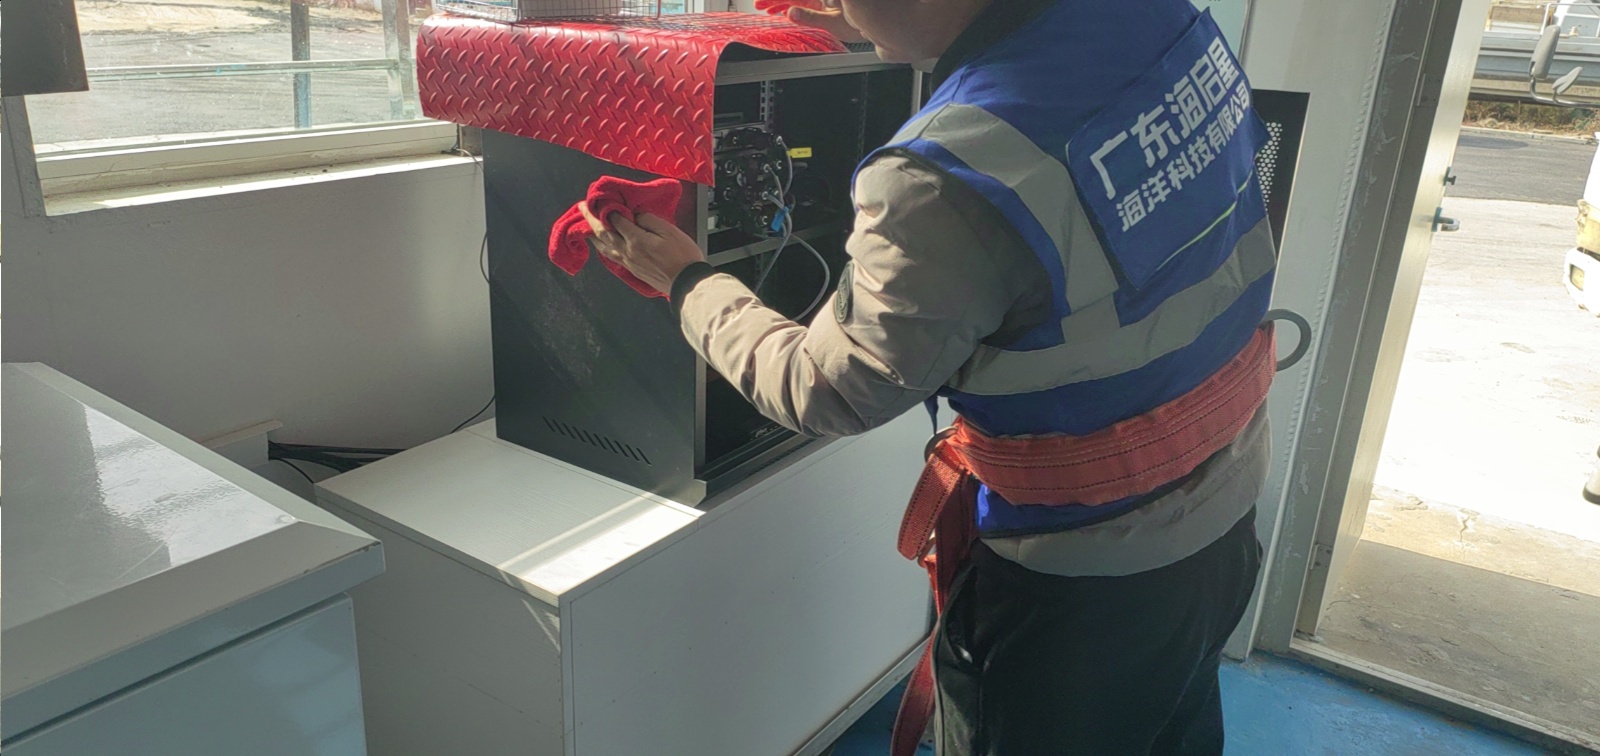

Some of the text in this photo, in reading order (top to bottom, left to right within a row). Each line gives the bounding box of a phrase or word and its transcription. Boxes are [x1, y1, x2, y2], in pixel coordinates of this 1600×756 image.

[1090, 36, 1239, 200] 广东海启星
[1116, 80, 1250, 232] 海洋科技有限公司
